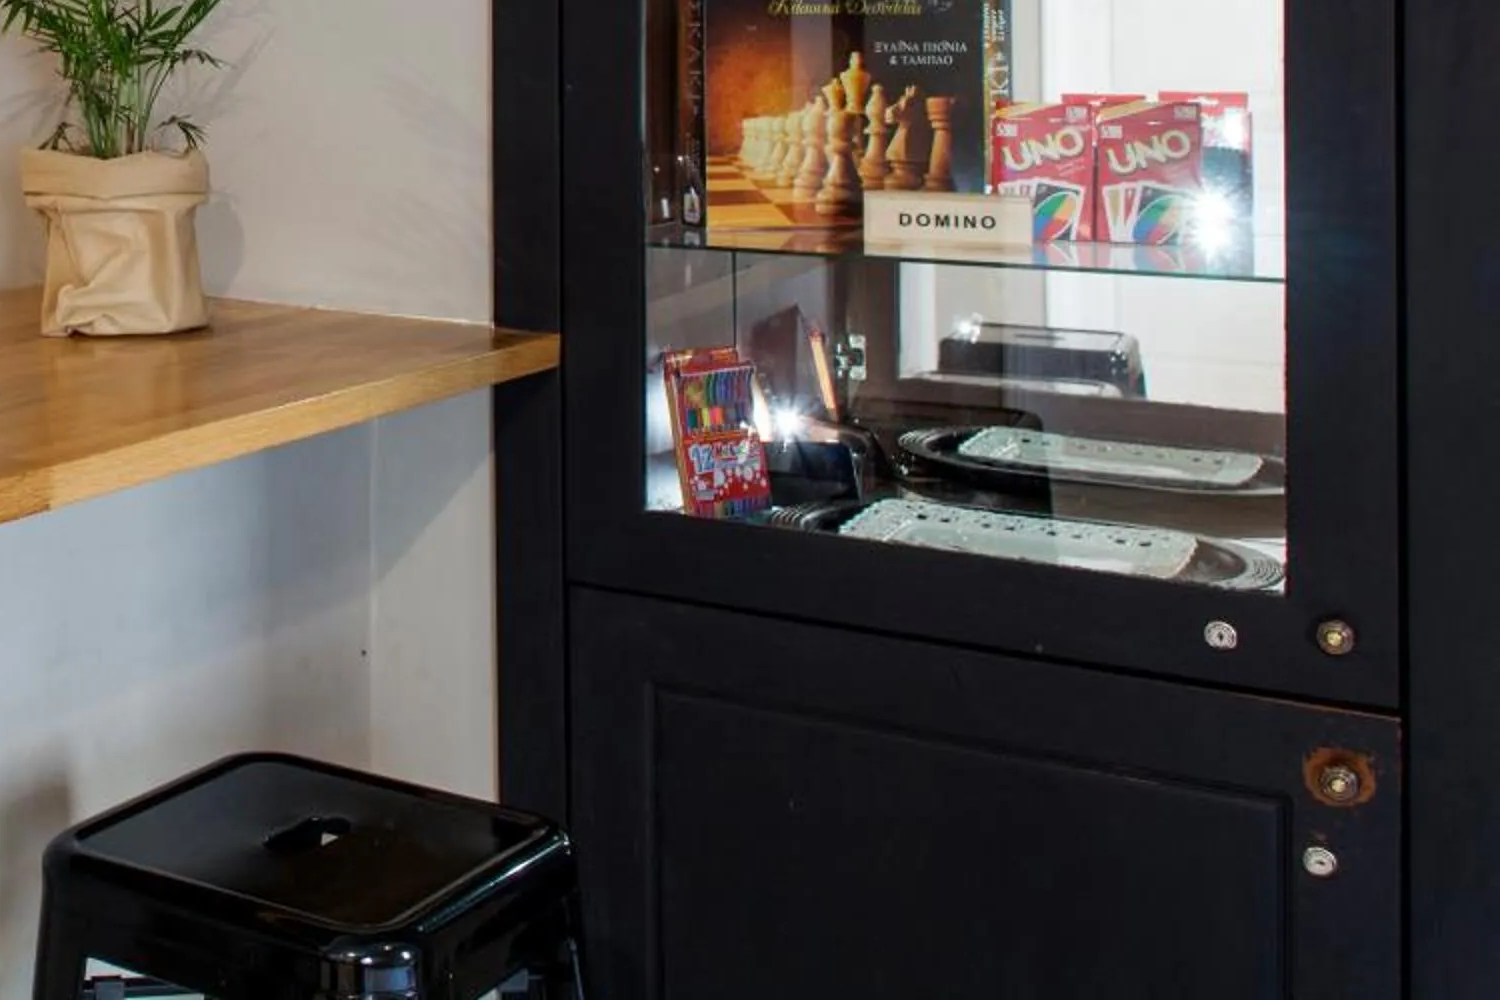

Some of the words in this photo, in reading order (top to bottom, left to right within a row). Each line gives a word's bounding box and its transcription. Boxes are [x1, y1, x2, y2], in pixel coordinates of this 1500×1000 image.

[1002, 126, 1084, 171] UNO
[1107, 129, 1190, 173] UNO
[899, 213, 996, 230] DOMINO
